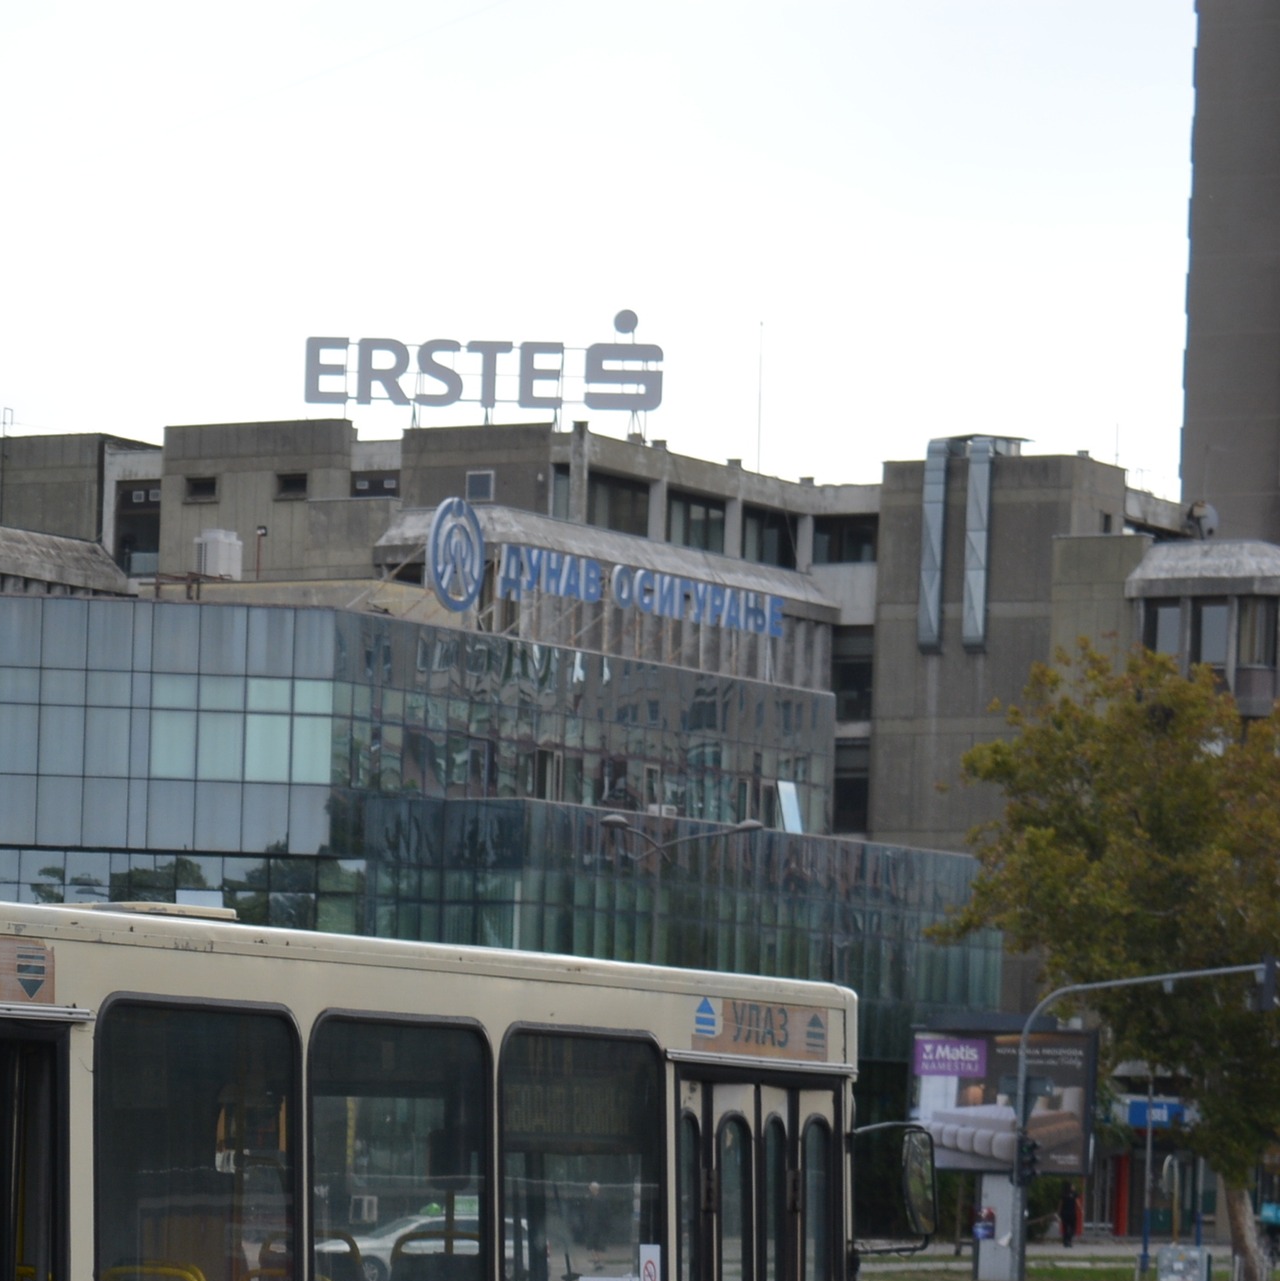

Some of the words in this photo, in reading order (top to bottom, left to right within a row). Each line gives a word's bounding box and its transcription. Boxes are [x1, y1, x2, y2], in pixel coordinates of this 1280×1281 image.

[303, 336, 564, 408] ERSTE
[496, 543, 603, 604] ДУНАВ
[610, 564, 786, 637] ОСИГУРАЊЕ
[731, 1001, 790, 1049] УЛАЗ
[935, 1044, 979, 1061] Matis
